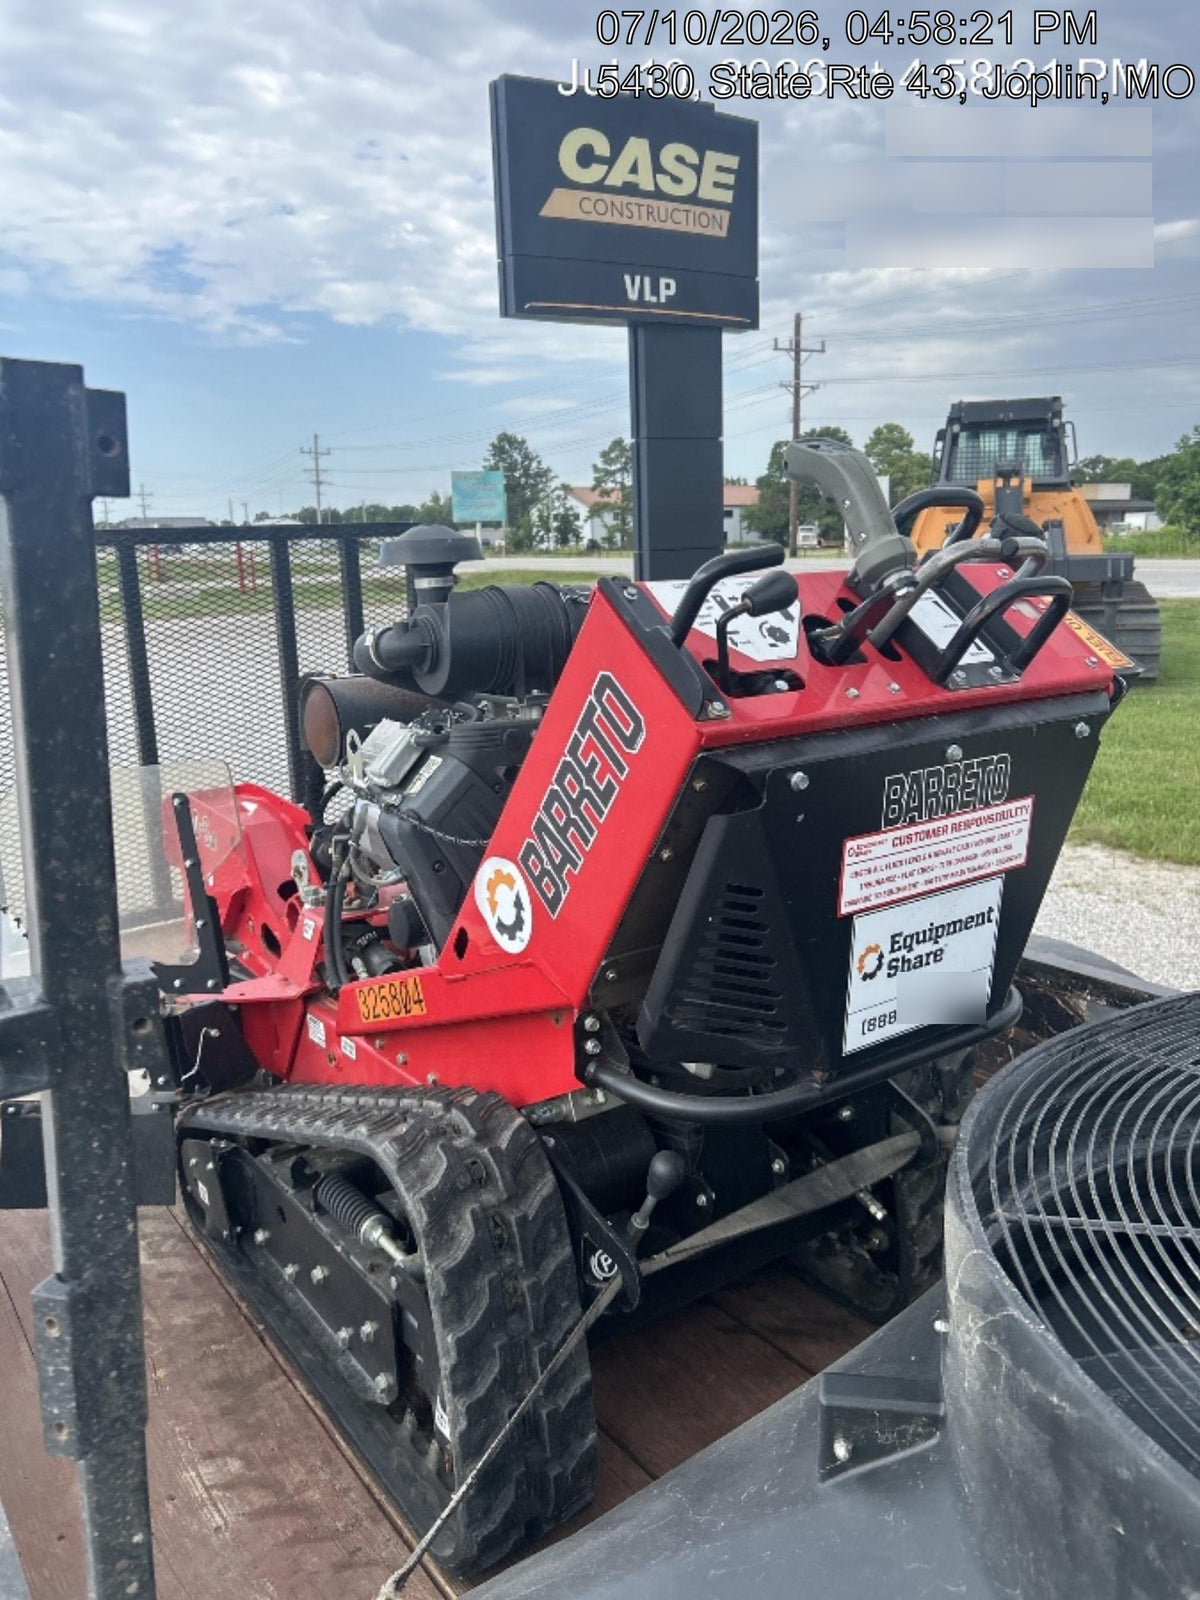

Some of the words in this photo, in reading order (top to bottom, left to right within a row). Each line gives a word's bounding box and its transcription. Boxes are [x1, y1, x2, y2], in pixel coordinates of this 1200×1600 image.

[558, 127, 740, 203] CASE
[579, 197, 723, 231] CONSTRUCTION
[624, 273, 677, 303] VLP
[517, 671, 646, 920] BARRETO
[881, 753, 1011, 830] BARRETO
[892, 824, 949, 848] CUSTOMER
[889, 906, 994, 954] Equipment
[887, 947, 945, 979] Share
[358, 977, 424, 1021] 325804
